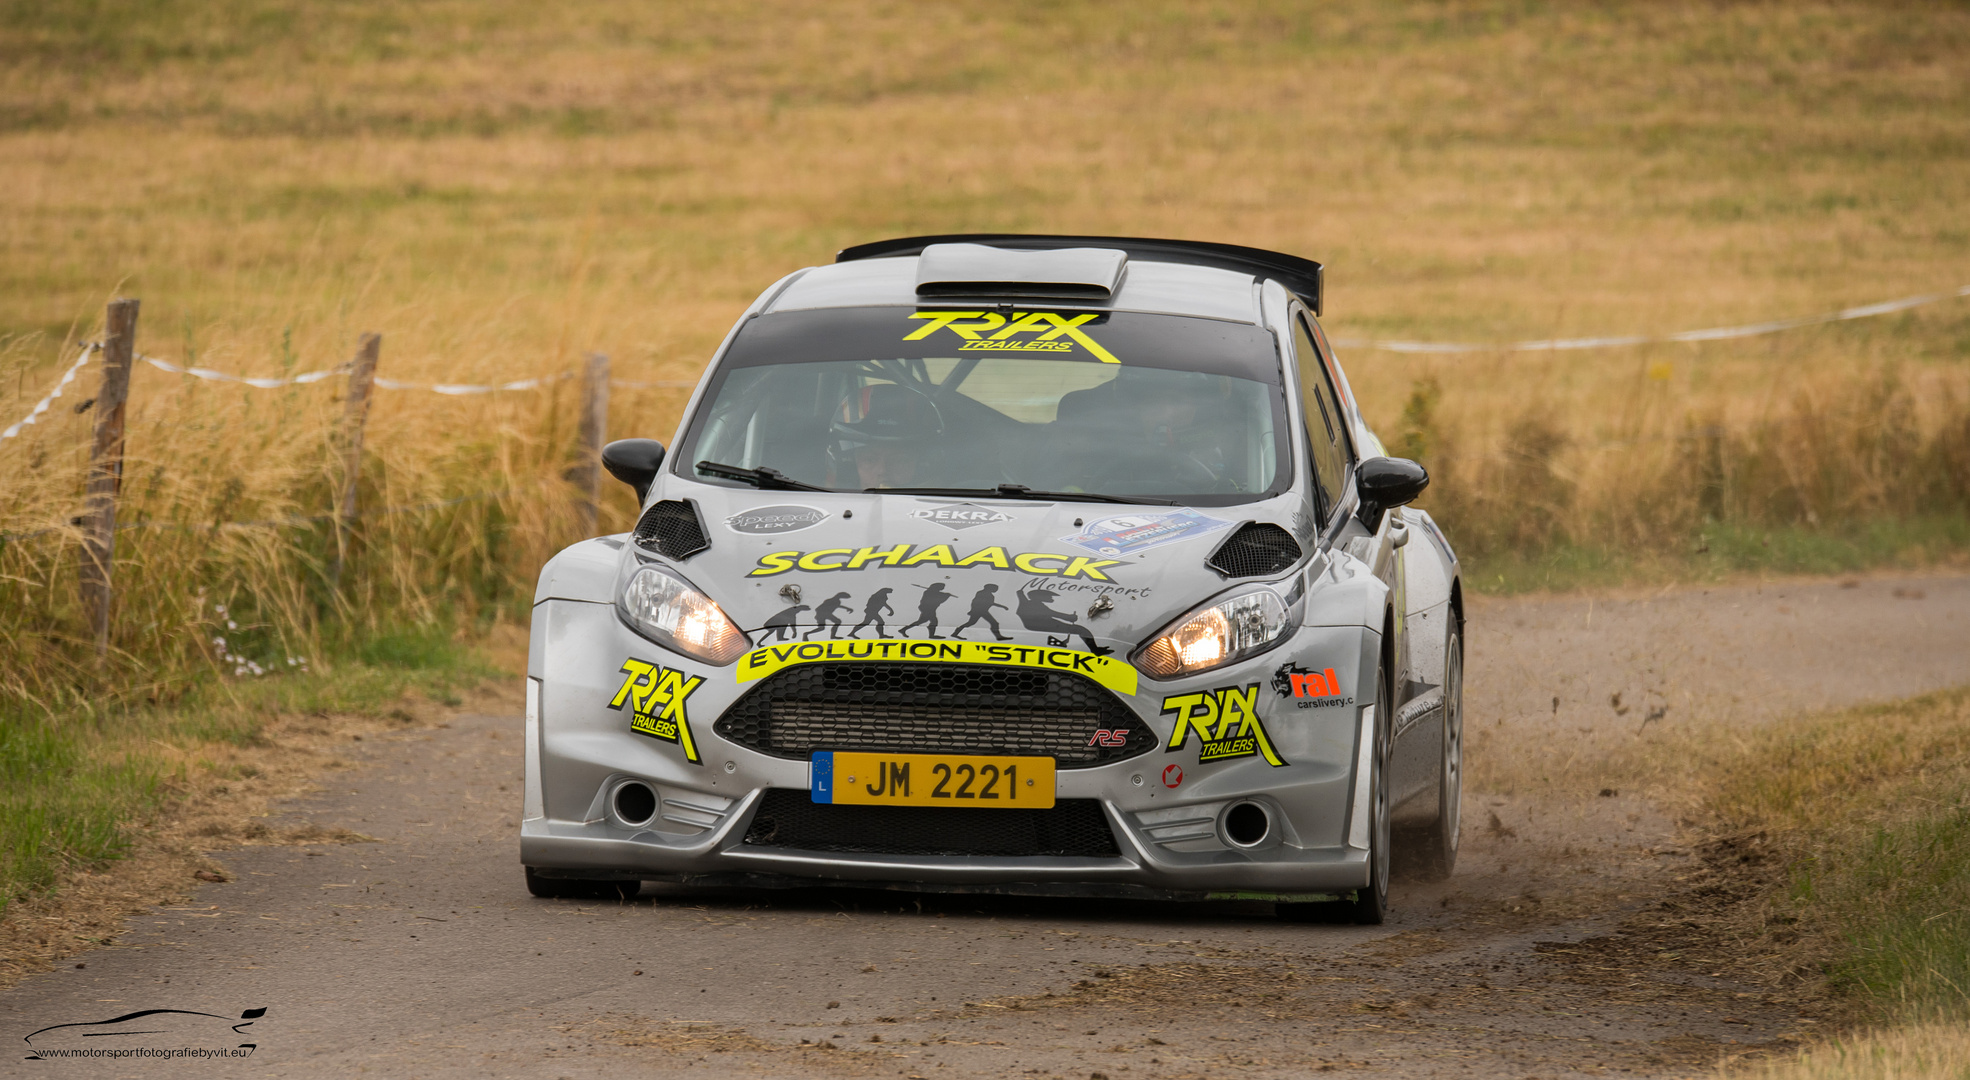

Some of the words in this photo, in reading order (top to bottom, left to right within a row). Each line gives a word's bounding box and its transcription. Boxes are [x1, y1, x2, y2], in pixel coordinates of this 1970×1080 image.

[902, 311, 1121, 363] TRAX
[962, 340, 1074, 351] TRAILERS
[755, 521, 797, 529] LEXY
[912, 505, 1010, 522] DEKRA
[1110, 518, 1136, 529] 6
[748, 544, 1124, 583] SCHAACK
[1021, 577, 1152, 599] Motorsport
[749, 642, 962, 669] EVOLUTION
[975, 644, 1109, 673] "STICK"
[1290, 667, 1341, 698] ral
[607, 657, 707, 766] TRAX
[632, 713, 677, 737] TRAILERS
[1161, 683, 1288, 767] TRAX
[1202, 738, 1255, 756] TRAILERS
[818, 781, 827, 792] L
[865, 761, 911, 798] JM
[931, 764, 1018, 800] 2221
